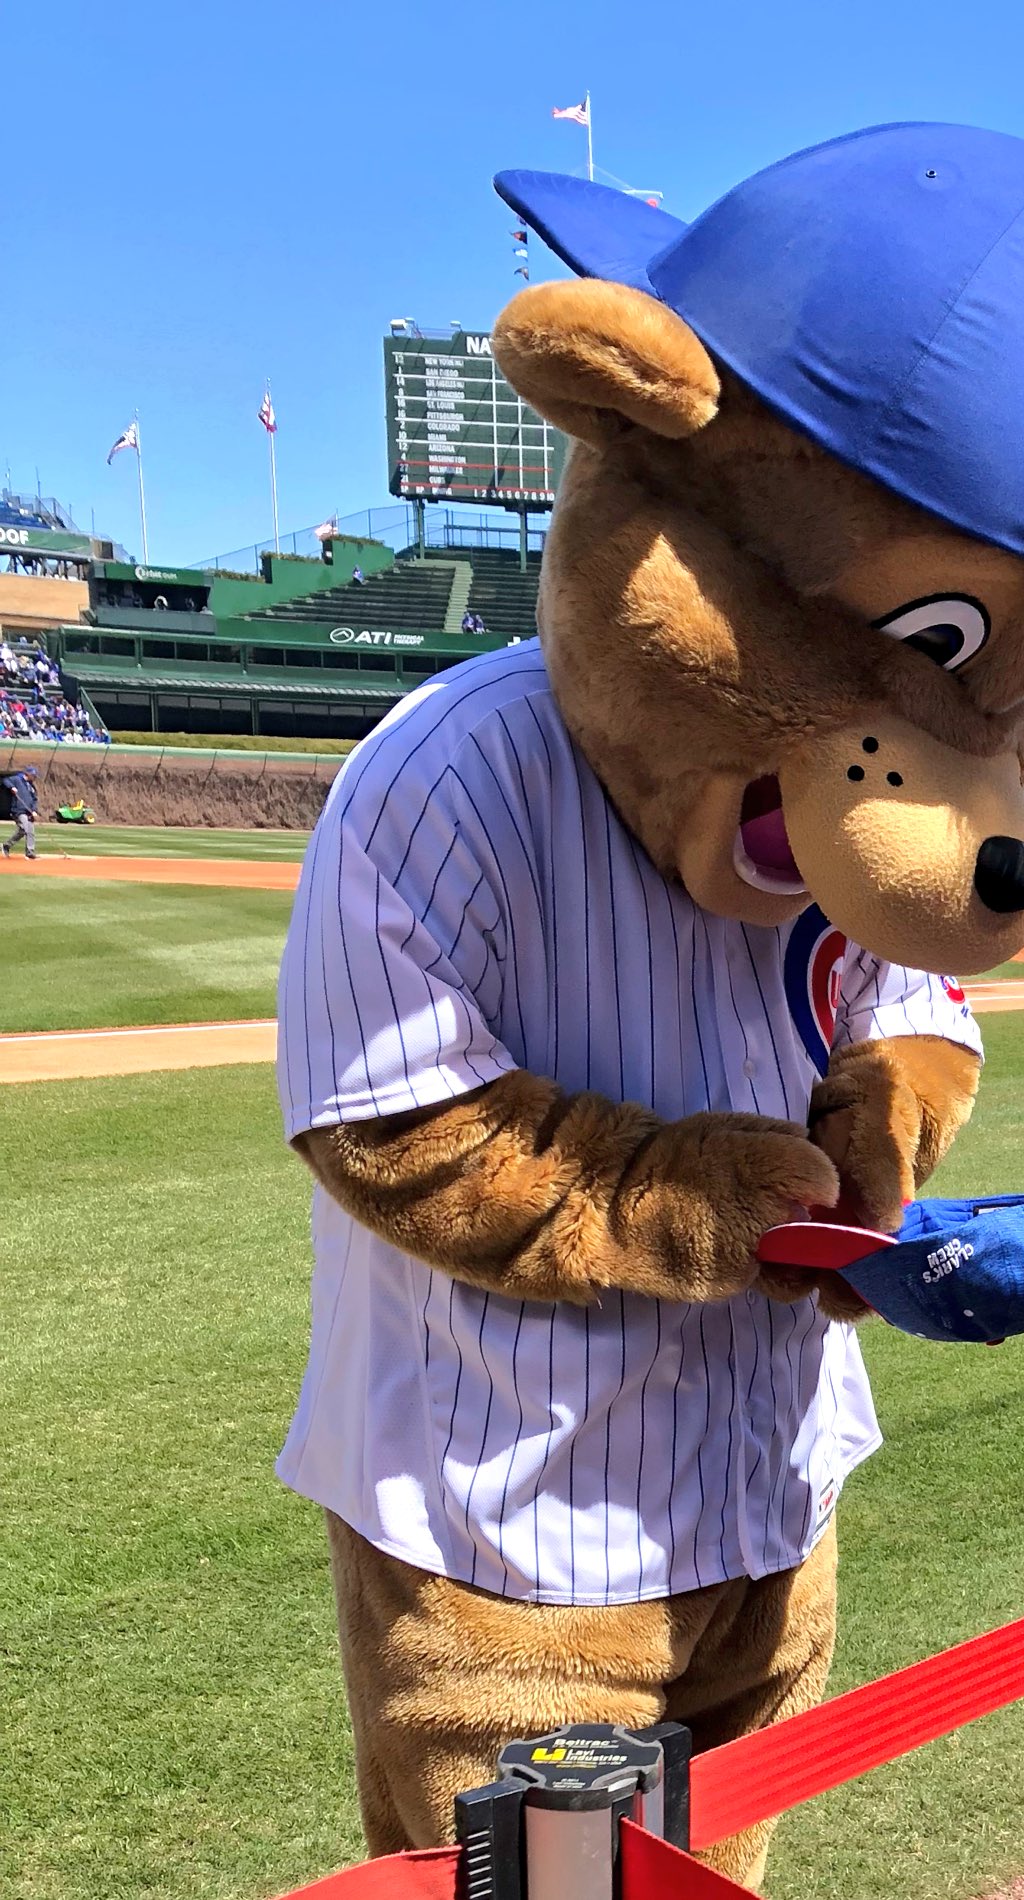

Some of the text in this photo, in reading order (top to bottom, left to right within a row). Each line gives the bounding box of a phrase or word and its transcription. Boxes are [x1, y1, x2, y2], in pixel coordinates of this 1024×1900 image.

[466, 336, 494, 354] NA
[428, 423, 460, 431] COLORADO
[474, 489, 554, 501] 1 2 3 4 5 6 7 8 9 10
[354, 630, 392, 645] ATI
[926, 1238, 961, 1269] CREW
[922, 1243, 974, 1283] CLARK'S
[565, 1754, 628, 1762] Industries
